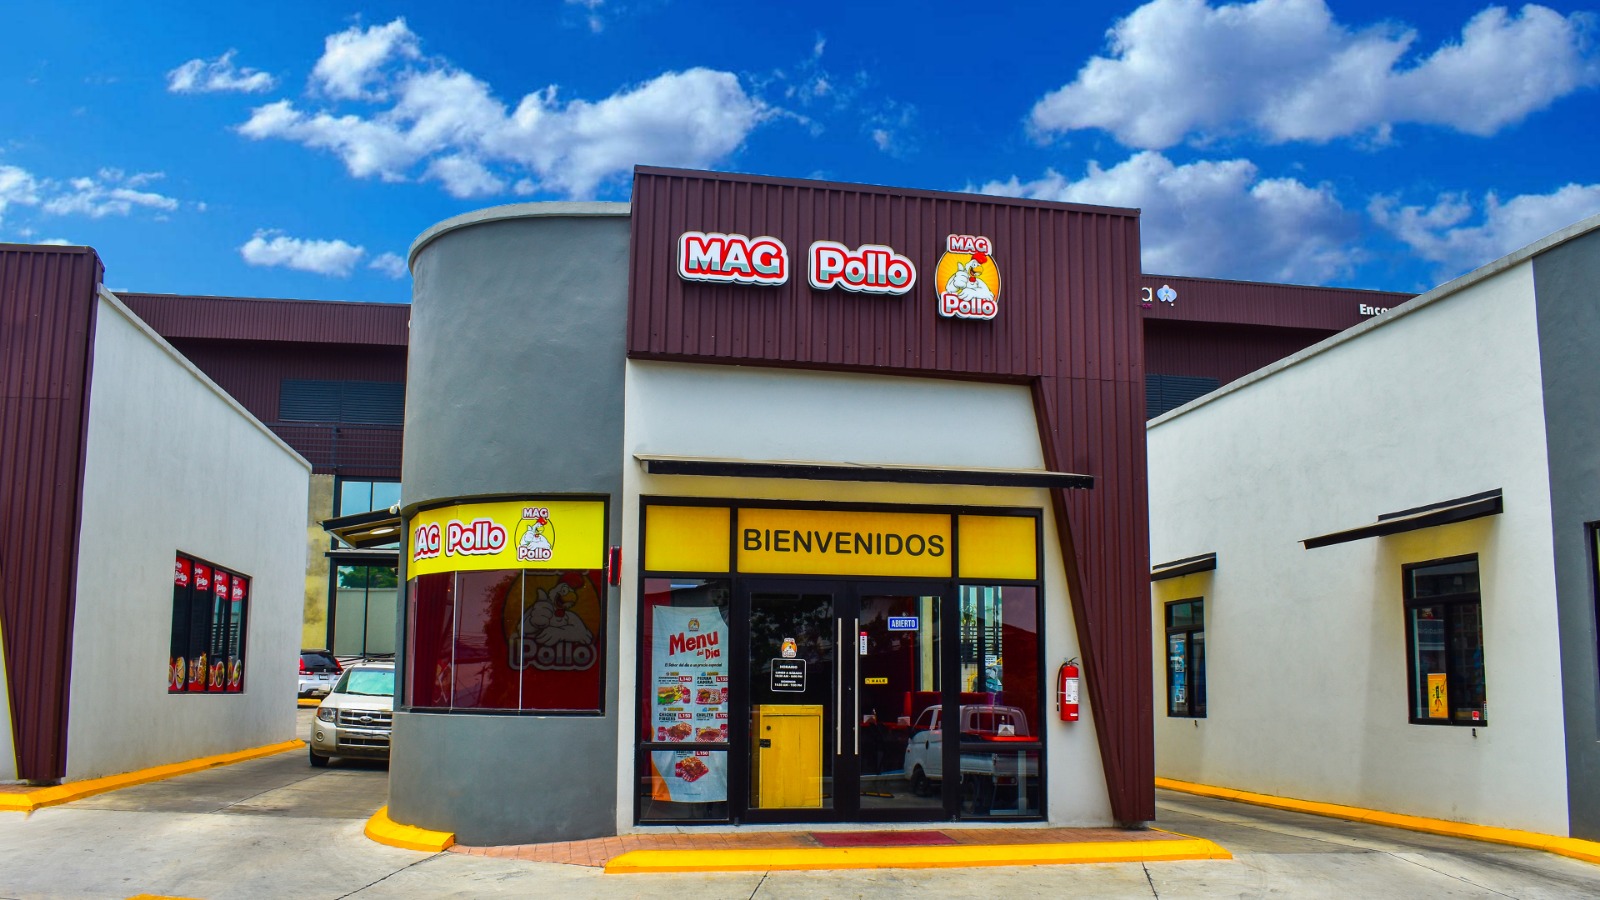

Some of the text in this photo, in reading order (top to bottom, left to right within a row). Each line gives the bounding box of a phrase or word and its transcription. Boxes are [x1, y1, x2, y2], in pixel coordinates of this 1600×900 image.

[951, 237, 988, 253] MAG
[687, 238, 911, 287] MAG Pollo
[945, 294, 994, 315] Pollo
[523, 508, 549, 518] MAG
[448, 522, 504, 552] Pollo
[743, 528, 945, 557] BIENVENIDOS
[519, 547, 551, 559] Pollo
[891, 619, 916, 628] ABIERTO
[515, 637, 592, 666] Pollo
